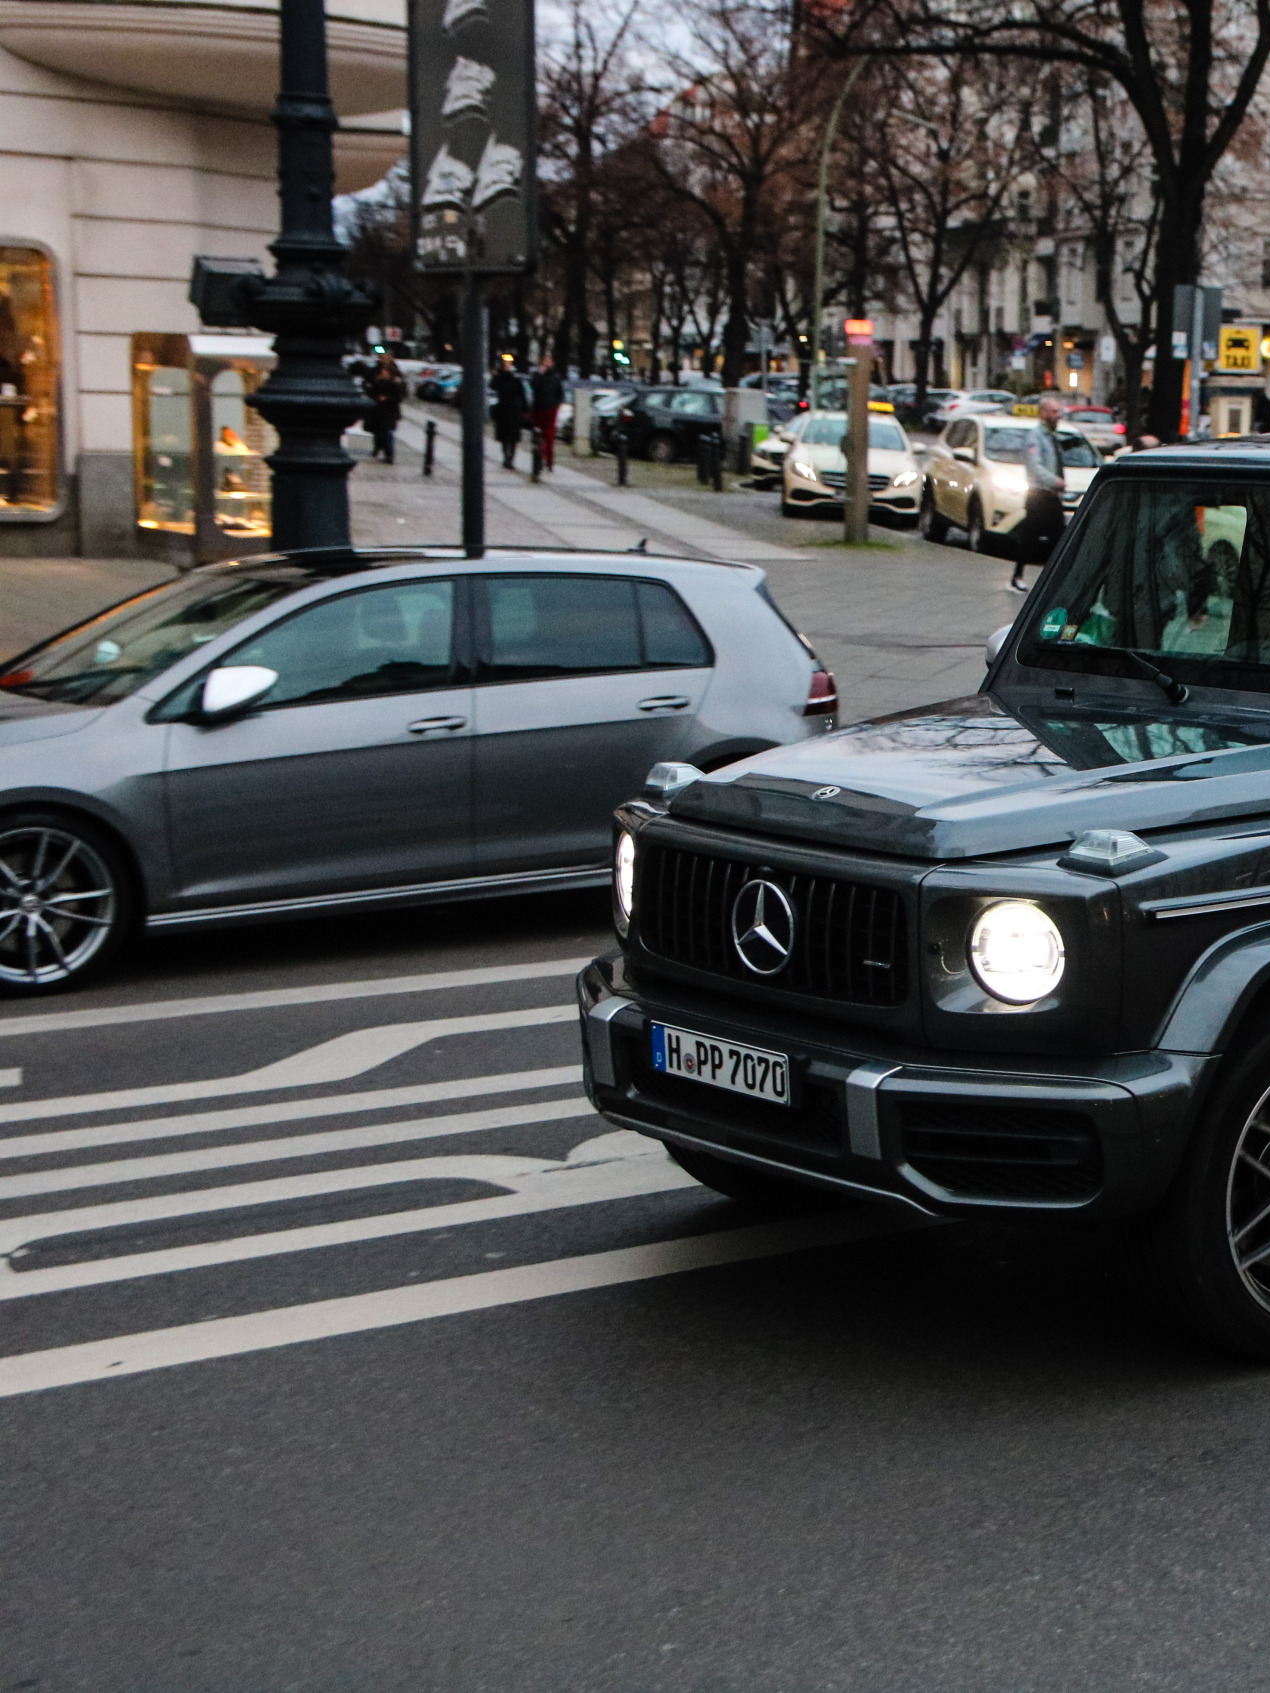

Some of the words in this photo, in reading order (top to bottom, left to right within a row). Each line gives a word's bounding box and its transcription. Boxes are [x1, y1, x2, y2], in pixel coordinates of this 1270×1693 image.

[1225, 354, 1253, 369] TAXI
[655, 1051, 663, 1063] D
[667, 1032, 682, 1071] H
[694, 1039, 723, 1081] PP
[728, 1048, 786, 1098] 7070
